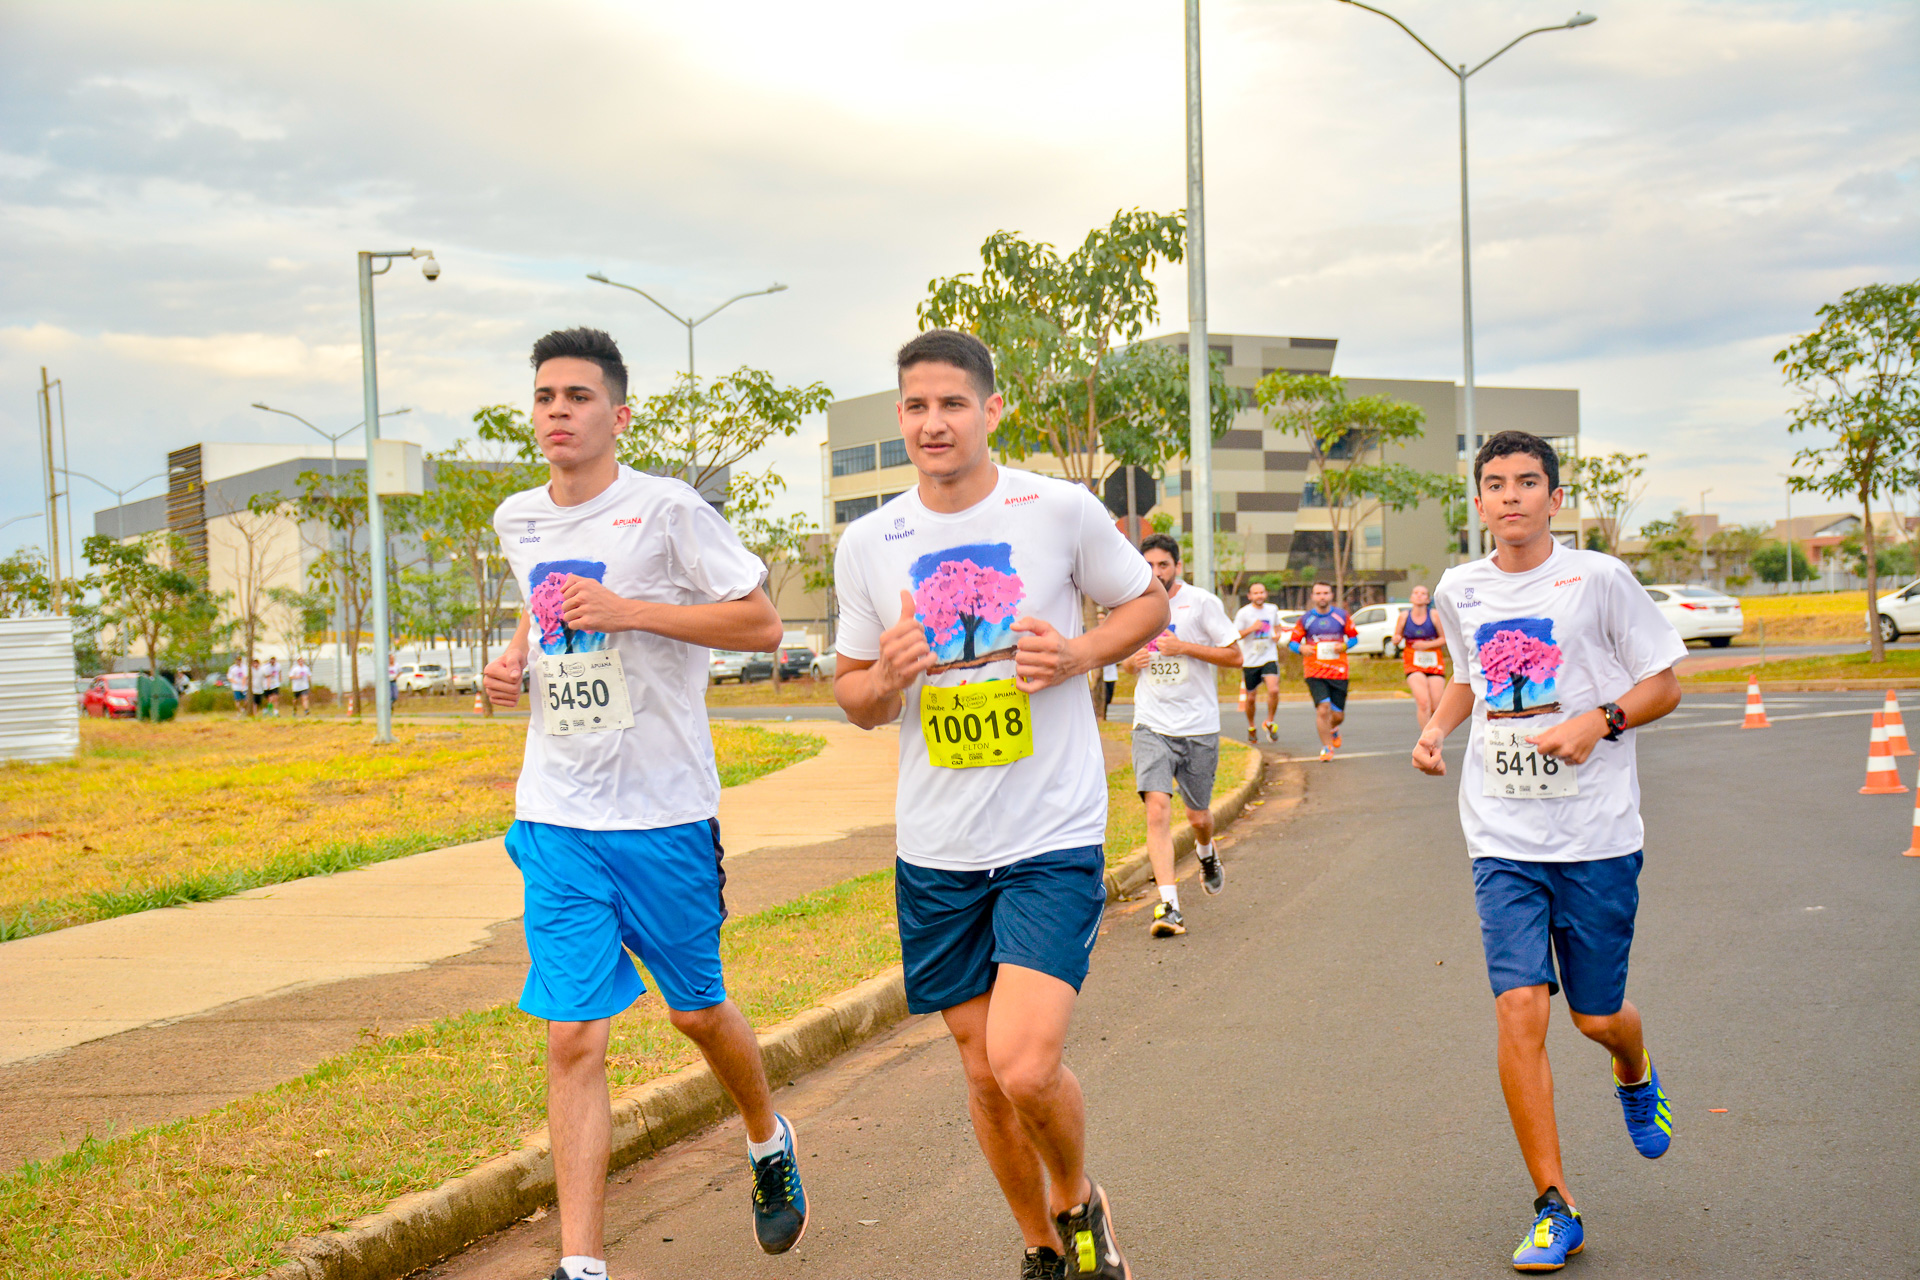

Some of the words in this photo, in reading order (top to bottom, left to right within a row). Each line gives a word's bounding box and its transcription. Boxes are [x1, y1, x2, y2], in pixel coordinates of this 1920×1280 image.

[1004, 494, 1040, 504] APUANA
[612, 517, 642, 526] APUANA
[519, 536, 541, 544] Uniube
[884, 529, 915, 542] Uniube
[1554, 576, 1582, 586] APUANA
[1457, 600, 1482, 609] Uniube
[1151, 662, 1180, 675] 5323
[549, 679, 609, 710] 5450
[994, 691, 1017, 699] APUANA
[928, 707, 1023, 743] 10018
[963, 743, 990, 751] ELTON
[1496, 751, 1559, 776] 5418
